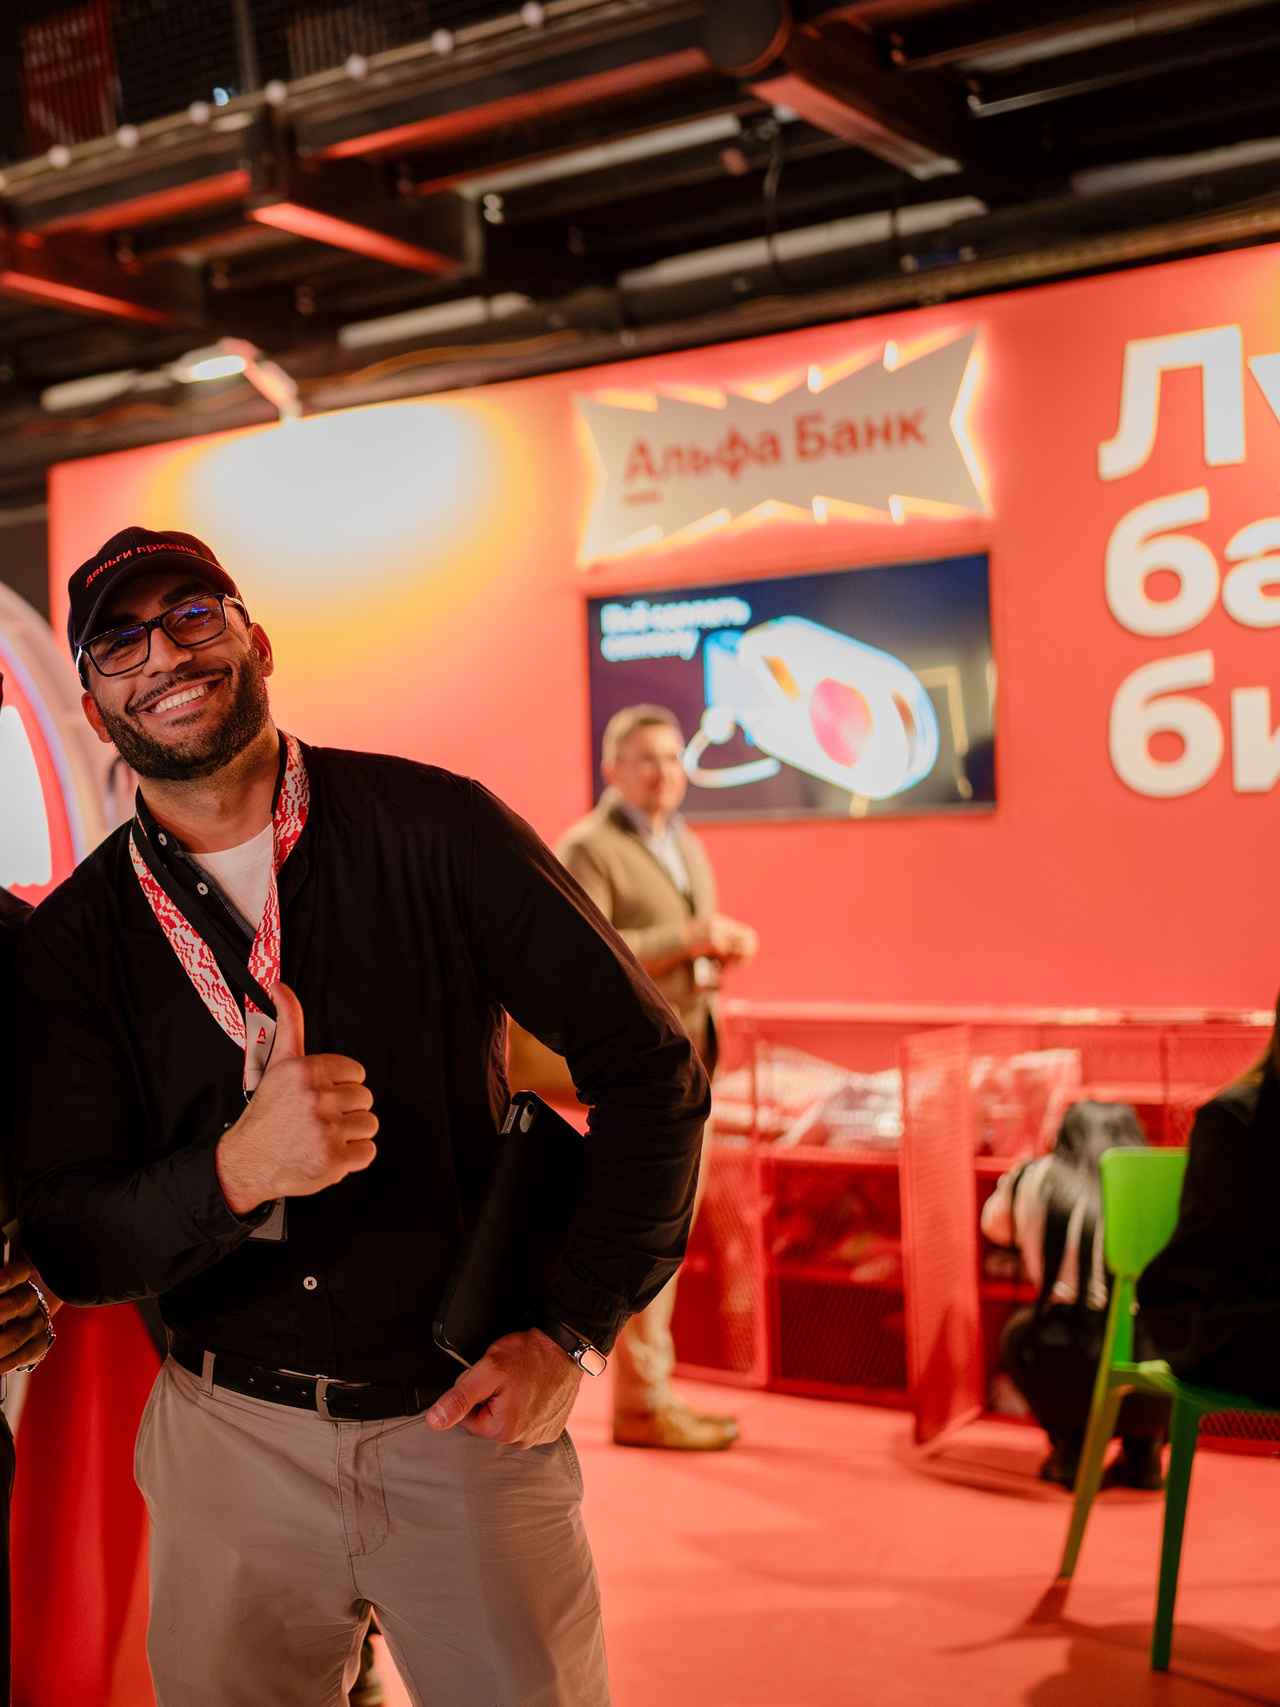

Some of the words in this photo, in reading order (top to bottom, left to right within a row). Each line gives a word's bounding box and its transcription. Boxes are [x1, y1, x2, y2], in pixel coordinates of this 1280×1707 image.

[1098, 324, 1280, 481] Л
[623, 424, 783, 484] Альфа
[794, 409, 926, 462] Банк
[86, 549, 133, 588] деньги
